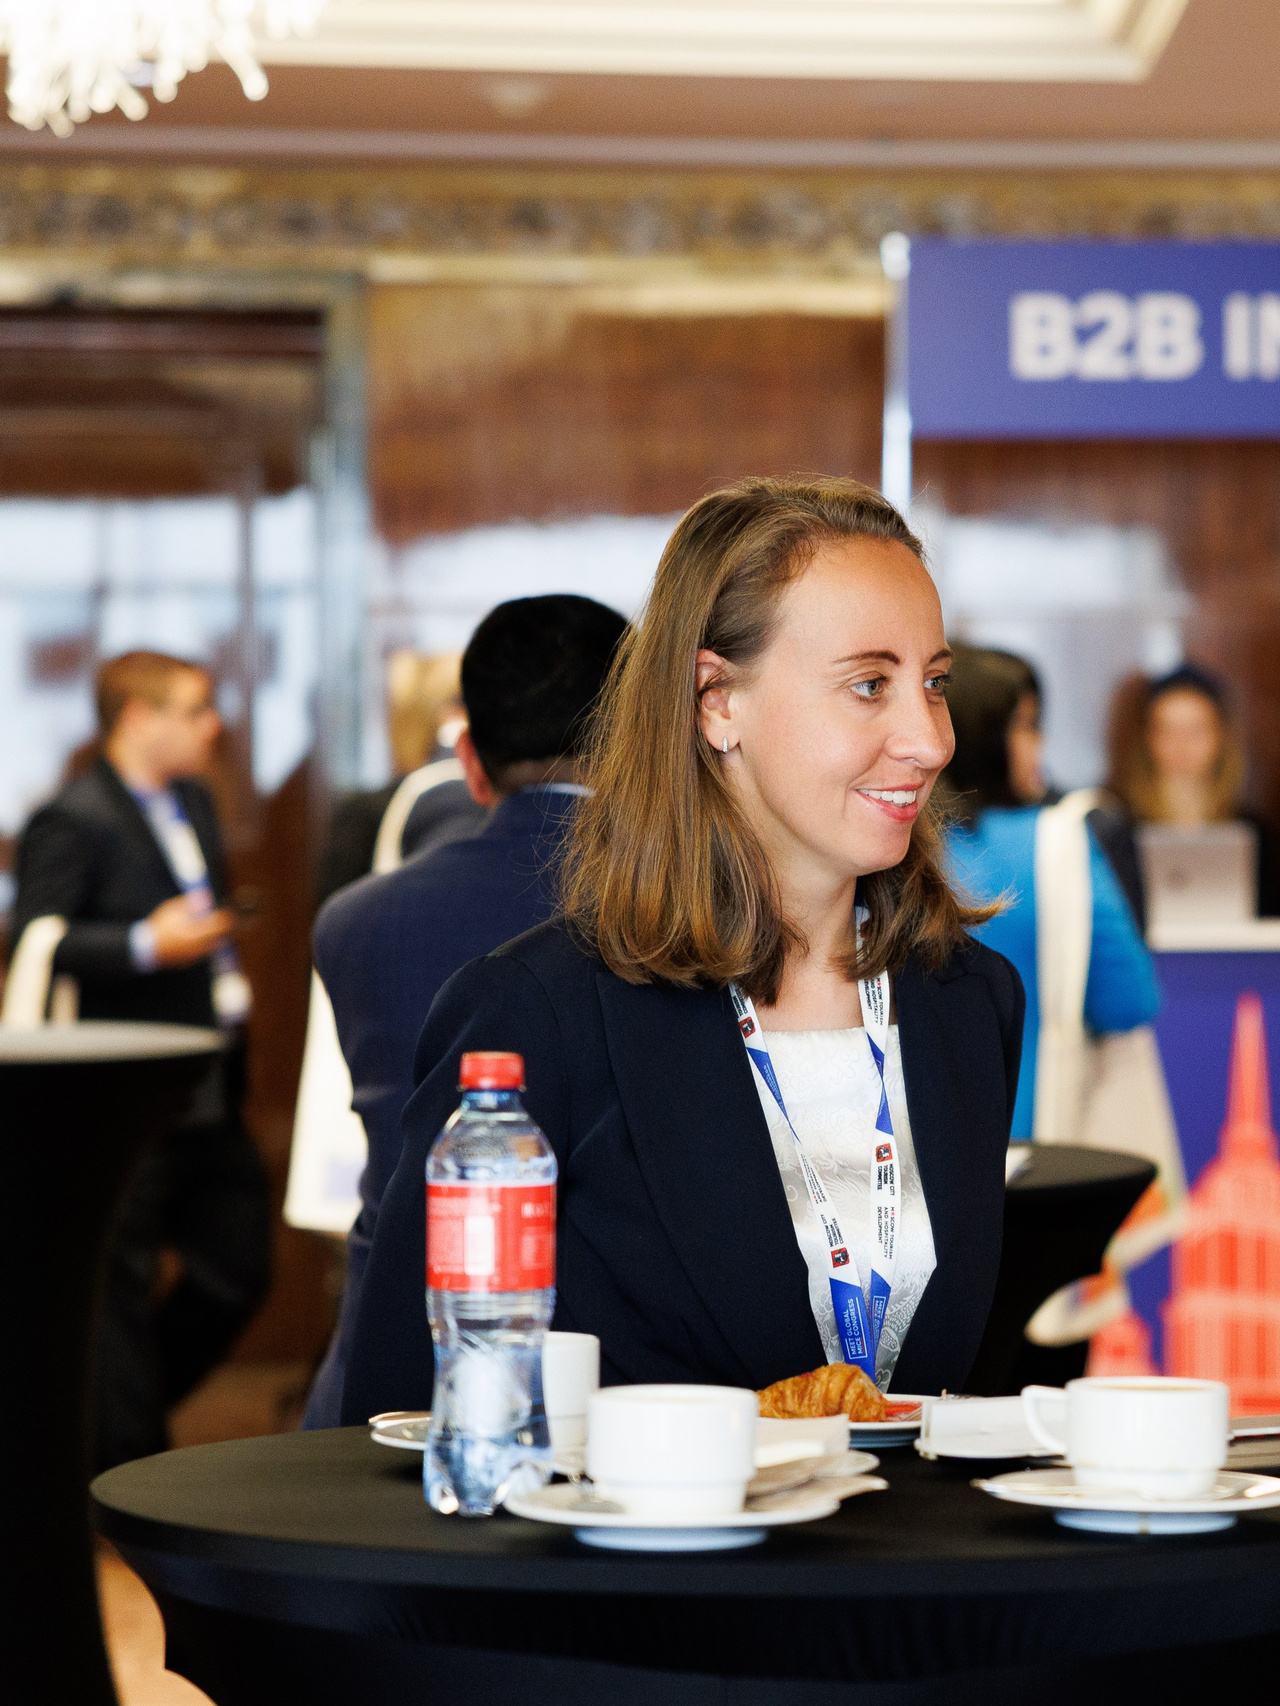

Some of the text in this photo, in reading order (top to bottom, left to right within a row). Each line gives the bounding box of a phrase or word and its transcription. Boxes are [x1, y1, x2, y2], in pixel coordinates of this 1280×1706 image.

[1008, 292, 1202, 380] B2B
[843, 1309, 857, 1355] MEET GLOBAL
[847, 1298, 864, 1355] MICE CONGRESS
